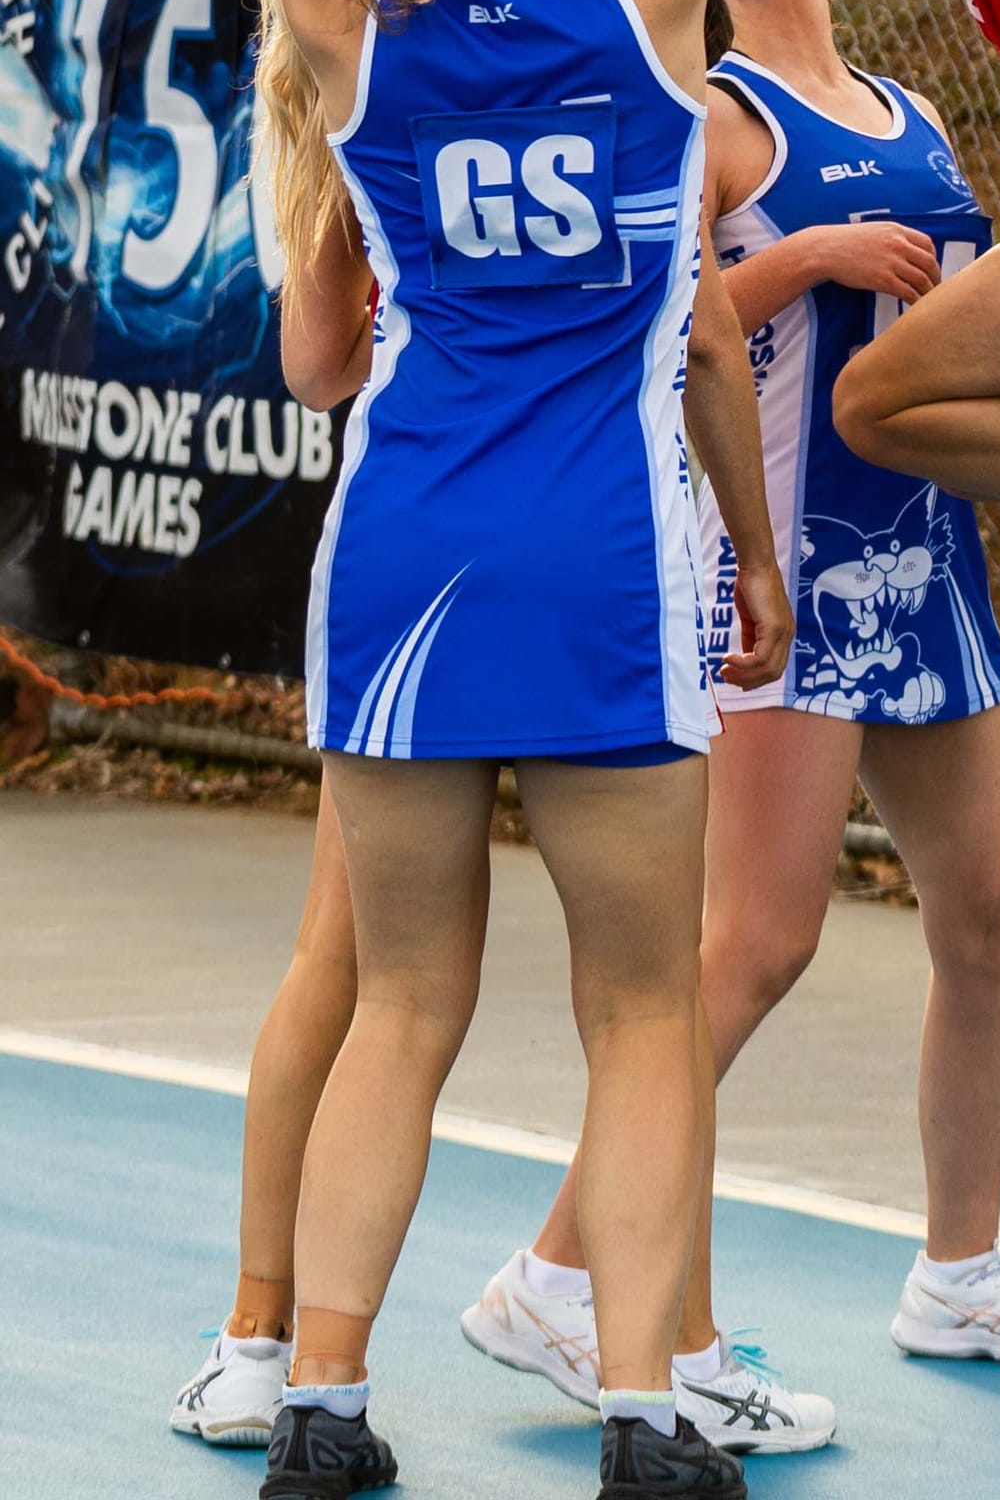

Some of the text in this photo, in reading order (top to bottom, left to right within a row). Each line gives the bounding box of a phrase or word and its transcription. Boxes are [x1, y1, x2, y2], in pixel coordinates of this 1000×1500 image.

[469, 2, 521, 24] BLK
[434, 133, 602, 260] GS
[819, 160, 883, 184] BLK
[204, 394, 334, 483] CLUB
